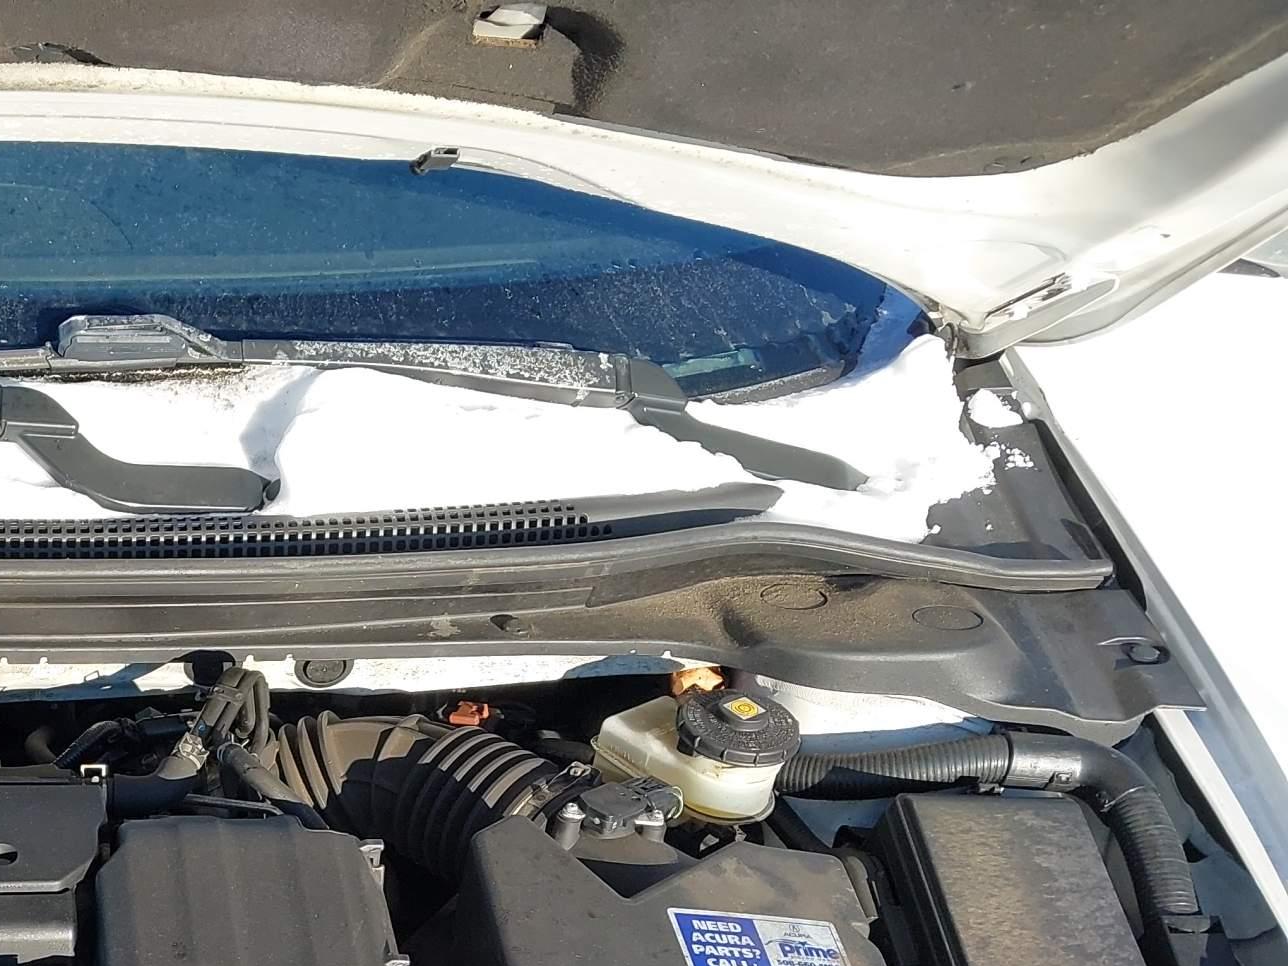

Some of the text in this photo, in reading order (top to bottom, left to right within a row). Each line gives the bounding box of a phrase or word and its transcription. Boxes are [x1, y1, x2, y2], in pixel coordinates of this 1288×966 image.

[692, 920, 742, 932] NEED
[692, 932, 755, 946] ACURA
[691, 944, 762, 960] PARTS?
